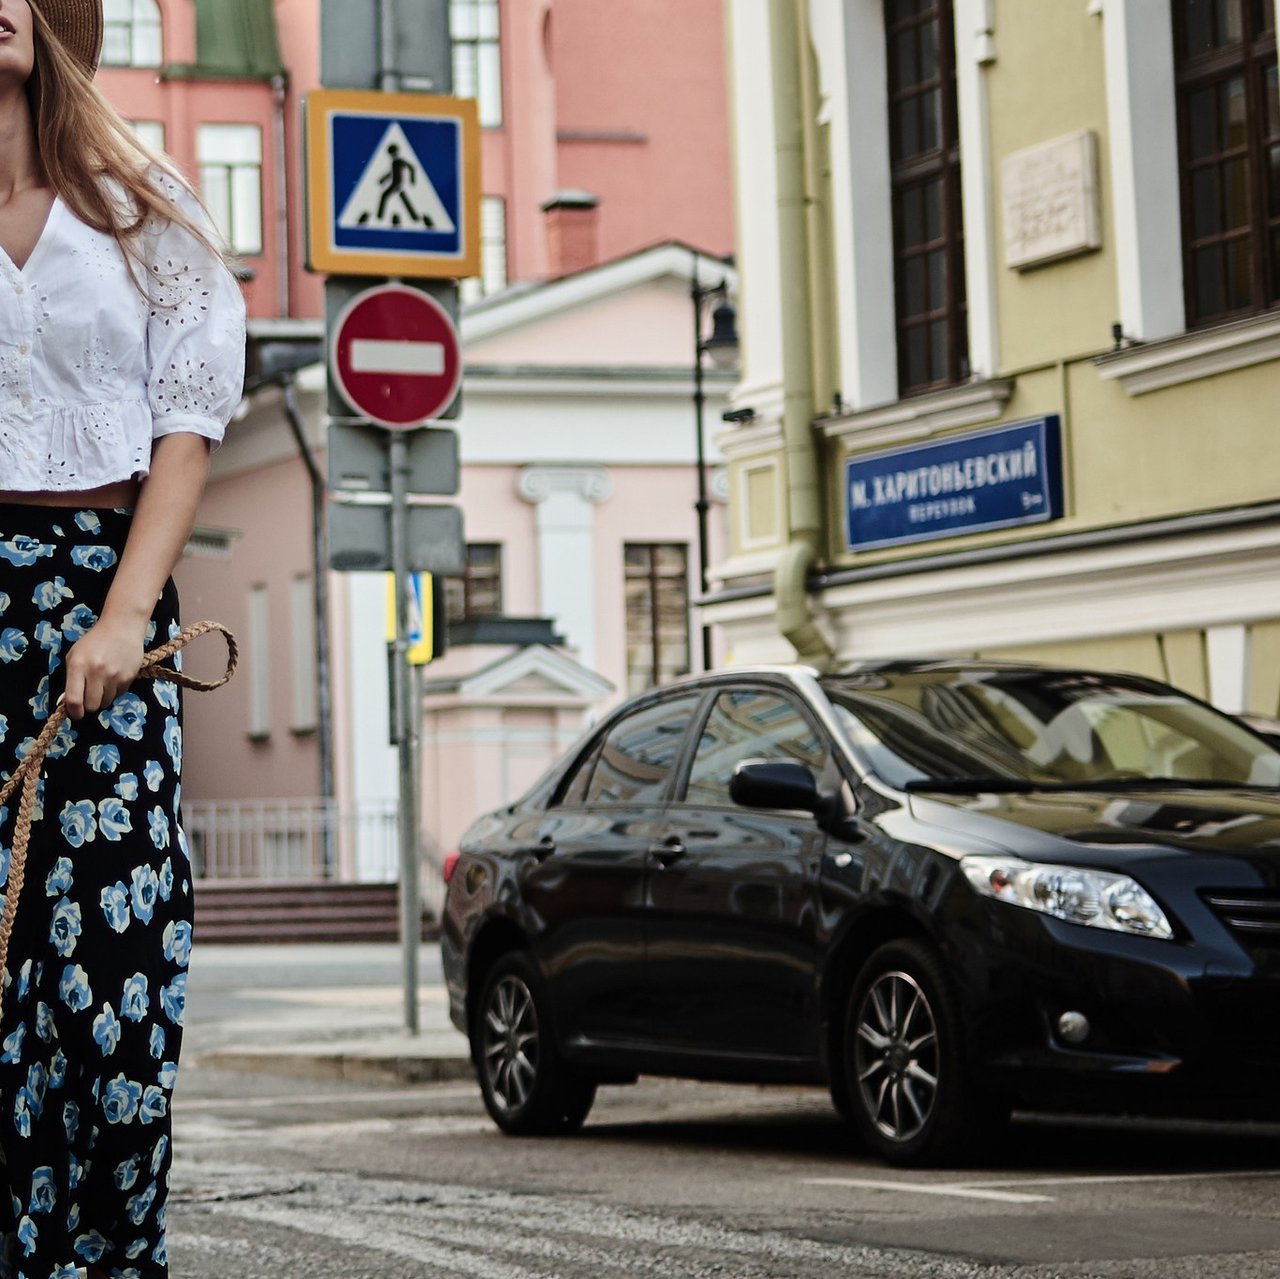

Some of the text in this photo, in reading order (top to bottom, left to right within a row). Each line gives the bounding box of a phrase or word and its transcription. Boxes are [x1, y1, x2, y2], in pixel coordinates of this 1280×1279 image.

[851, 440, 1037, 510] М. ХАРИТОНЬЕВСКИЙ
[909, 495, 976, 523] ПЕРЕУЛОК
